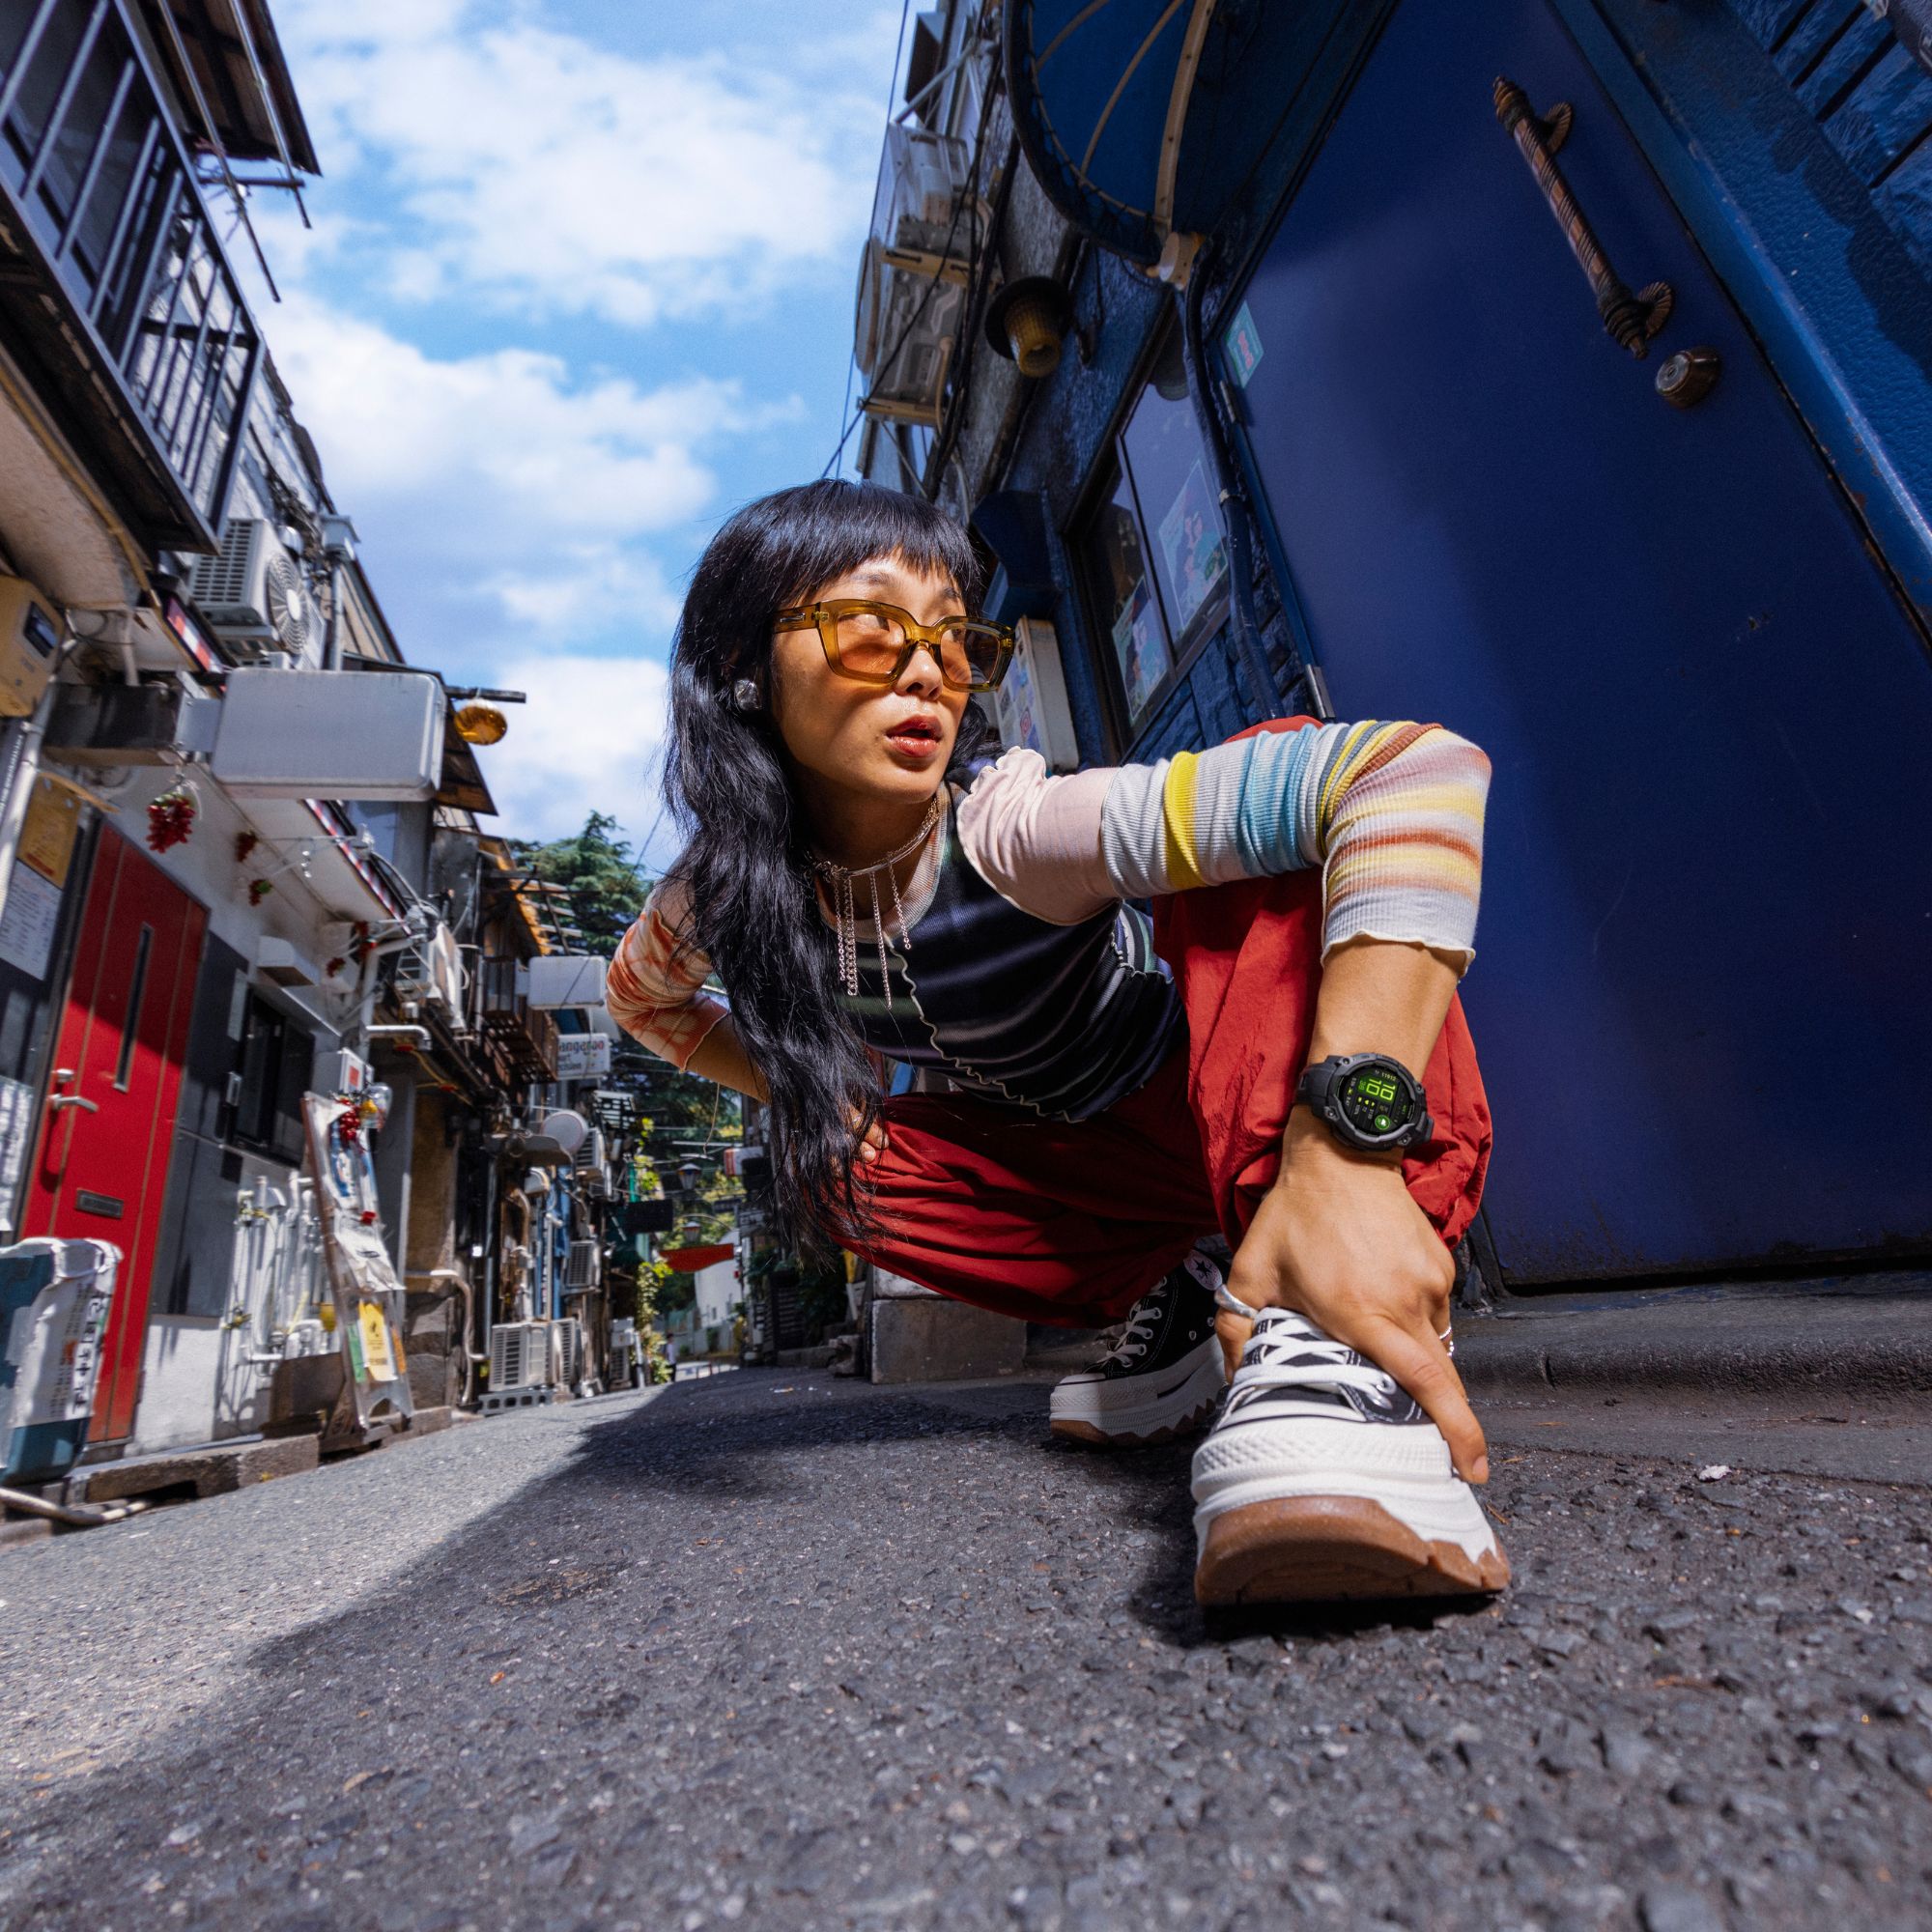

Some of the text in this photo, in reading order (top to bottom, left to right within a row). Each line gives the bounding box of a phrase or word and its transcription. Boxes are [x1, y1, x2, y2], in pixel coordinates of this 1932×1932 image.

[557, 1040, 605, 1056] angaroo
[1366, 1078, 1382, 1096] 10
[1380, 1084, 1395, 1101] 10
